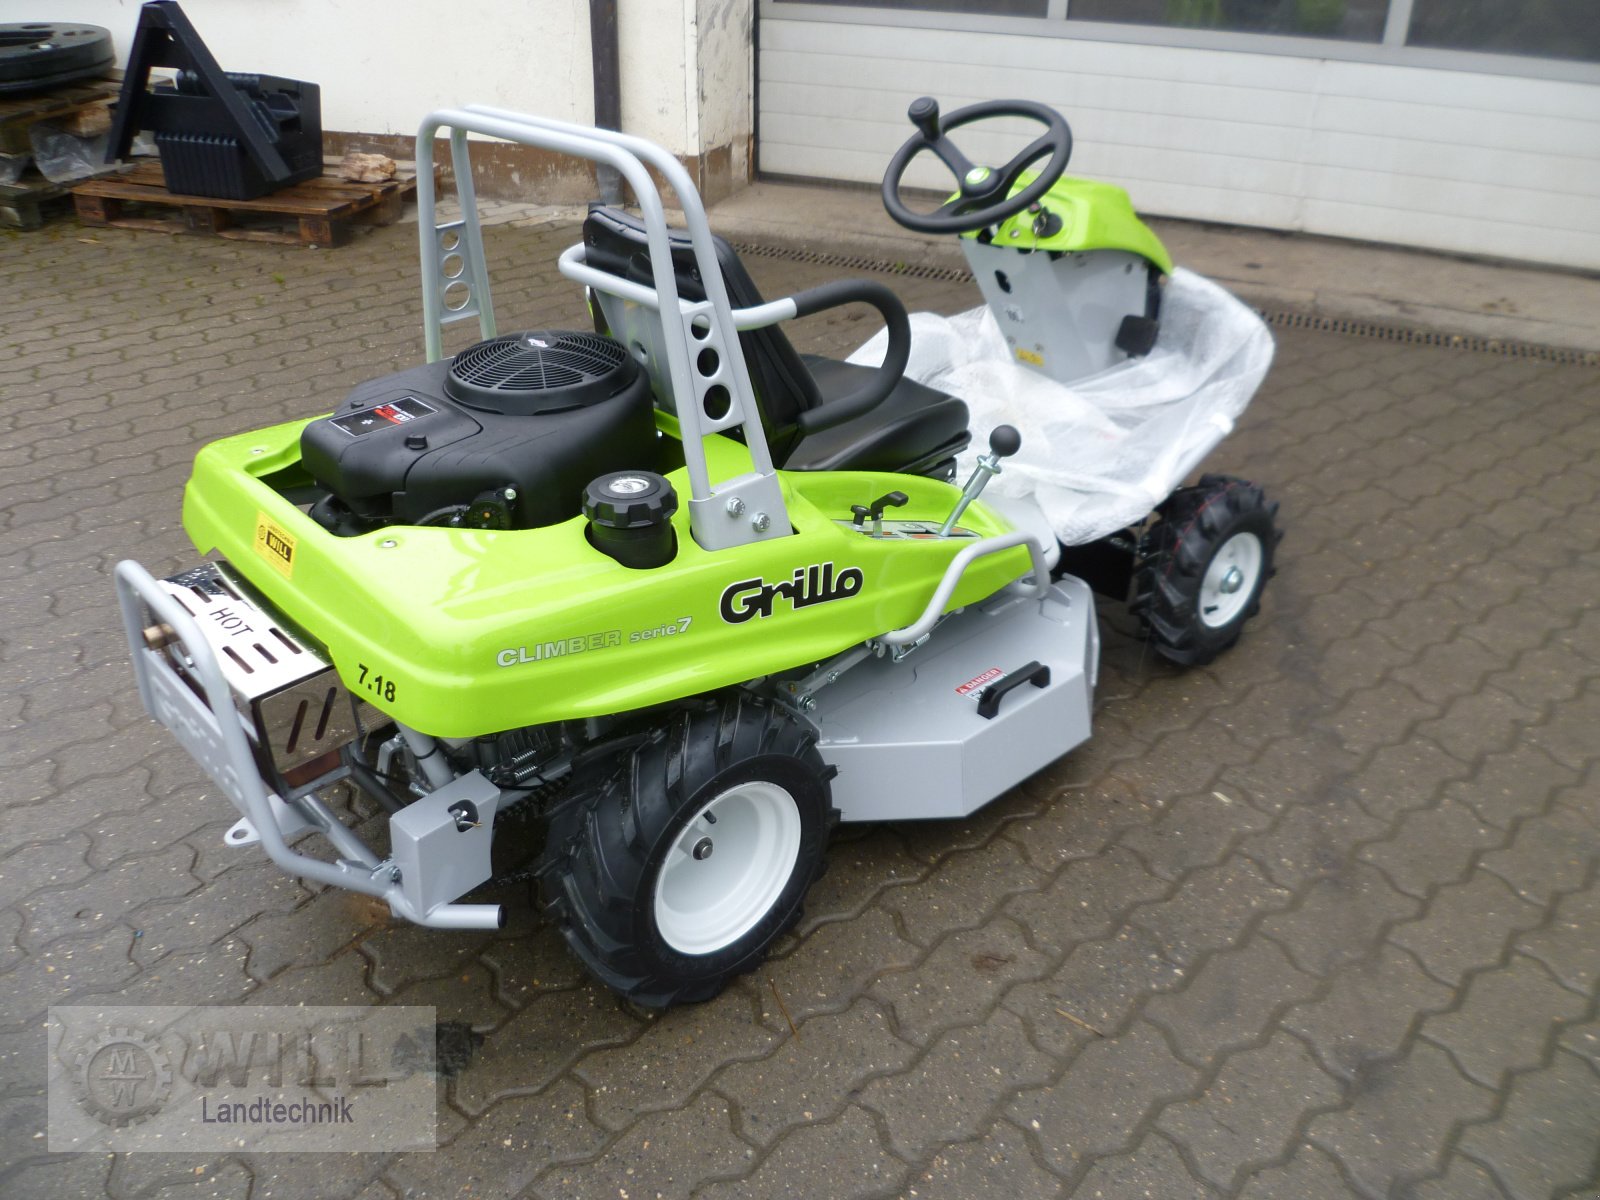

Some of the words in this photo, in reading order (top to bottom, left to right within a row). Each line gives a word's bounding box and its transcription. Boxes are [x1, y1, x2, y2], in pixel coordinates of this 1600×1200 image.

[269, 534, 288, 559] WILL
[720, 561, 864, 624] Grillo
[209, 607, 254, 636] HOT
[497, 630, 622, 668] CLIMBER
[358, 663, 396, 702] 7.18
[967, 669, 1001, 689] DANGER
